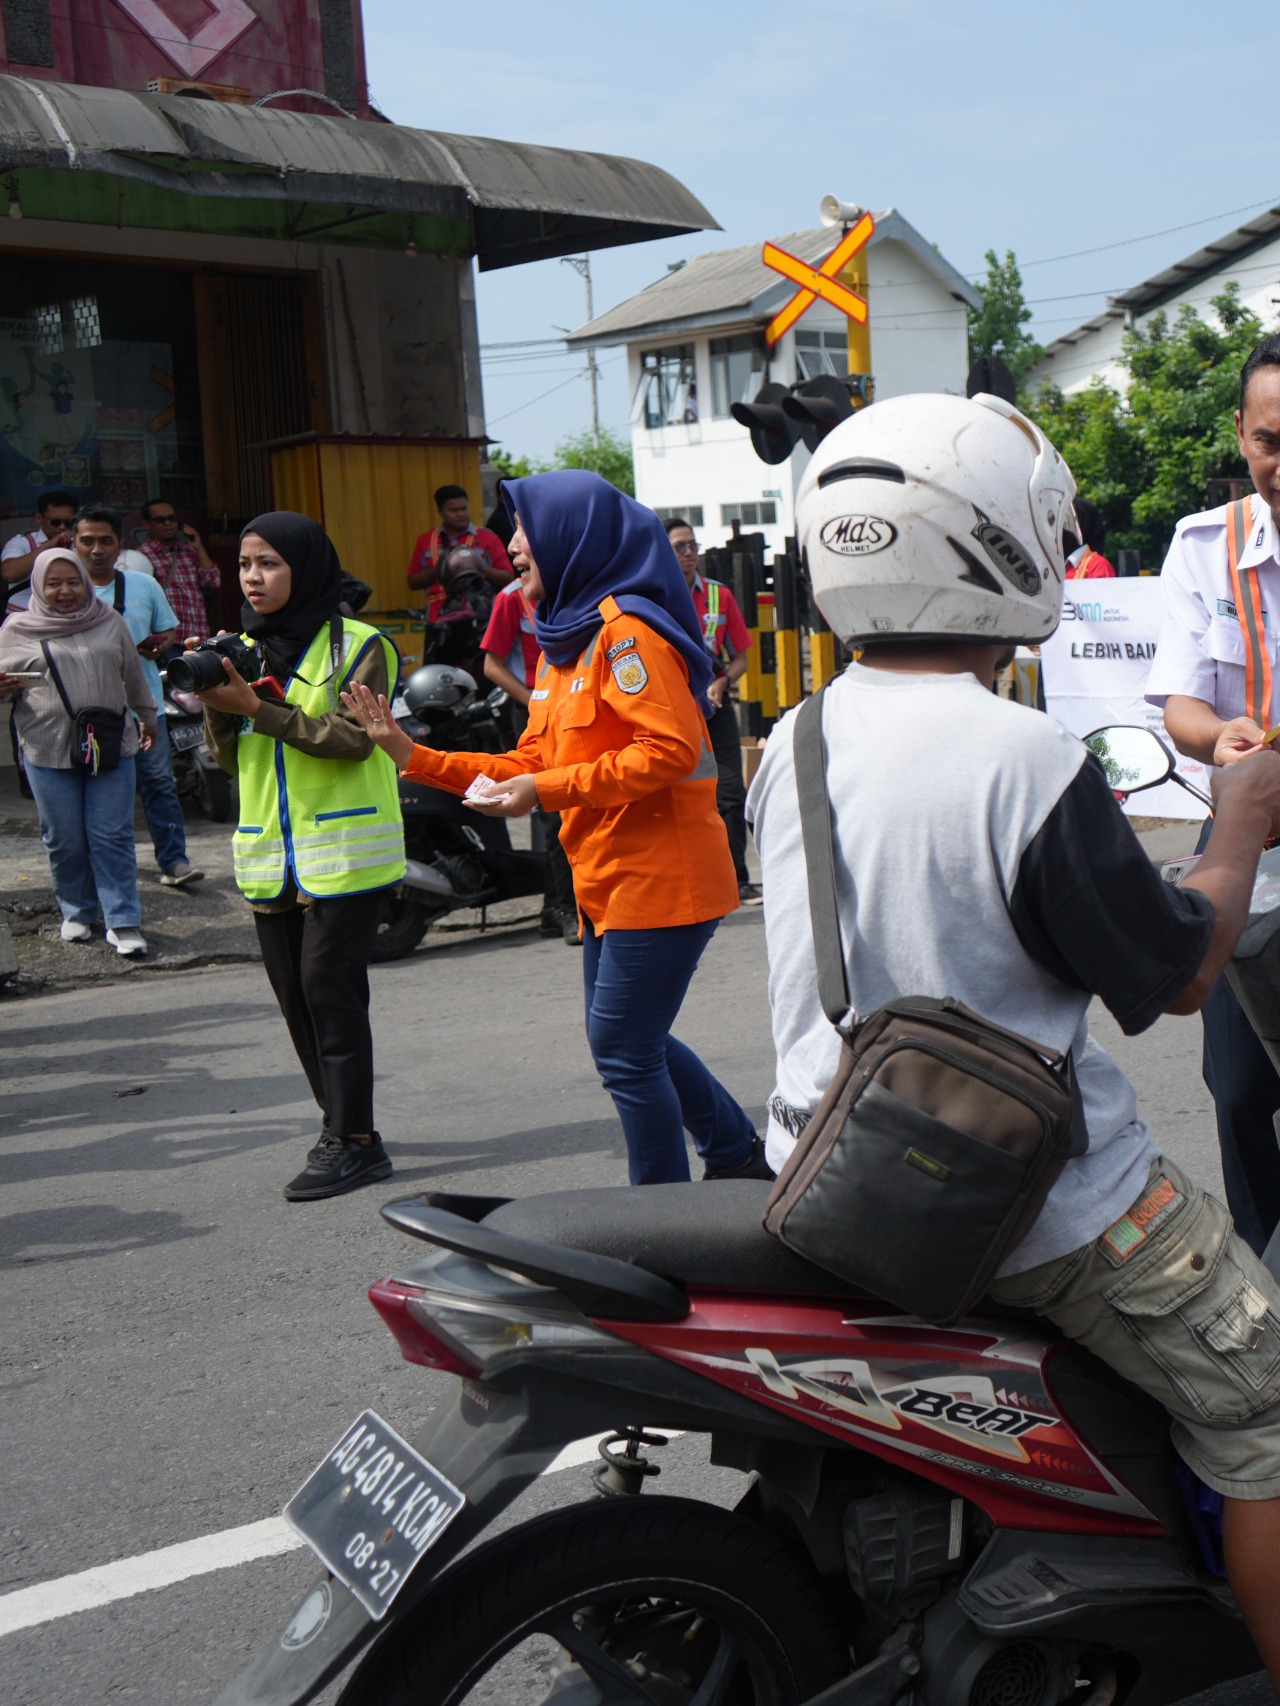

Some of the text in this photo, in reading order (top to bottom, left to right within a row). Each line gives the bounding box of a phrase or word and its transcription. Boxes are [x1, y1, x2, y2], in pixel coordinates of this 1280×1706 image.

[987, 534, 1037, 586] INK
[607, 641, 627, 660] DAOP
[1071, 642, 1122, 660] LEBIH
[331, 1424, 377, 1474] AG
[354, 1445, 416, 1515] 4814
